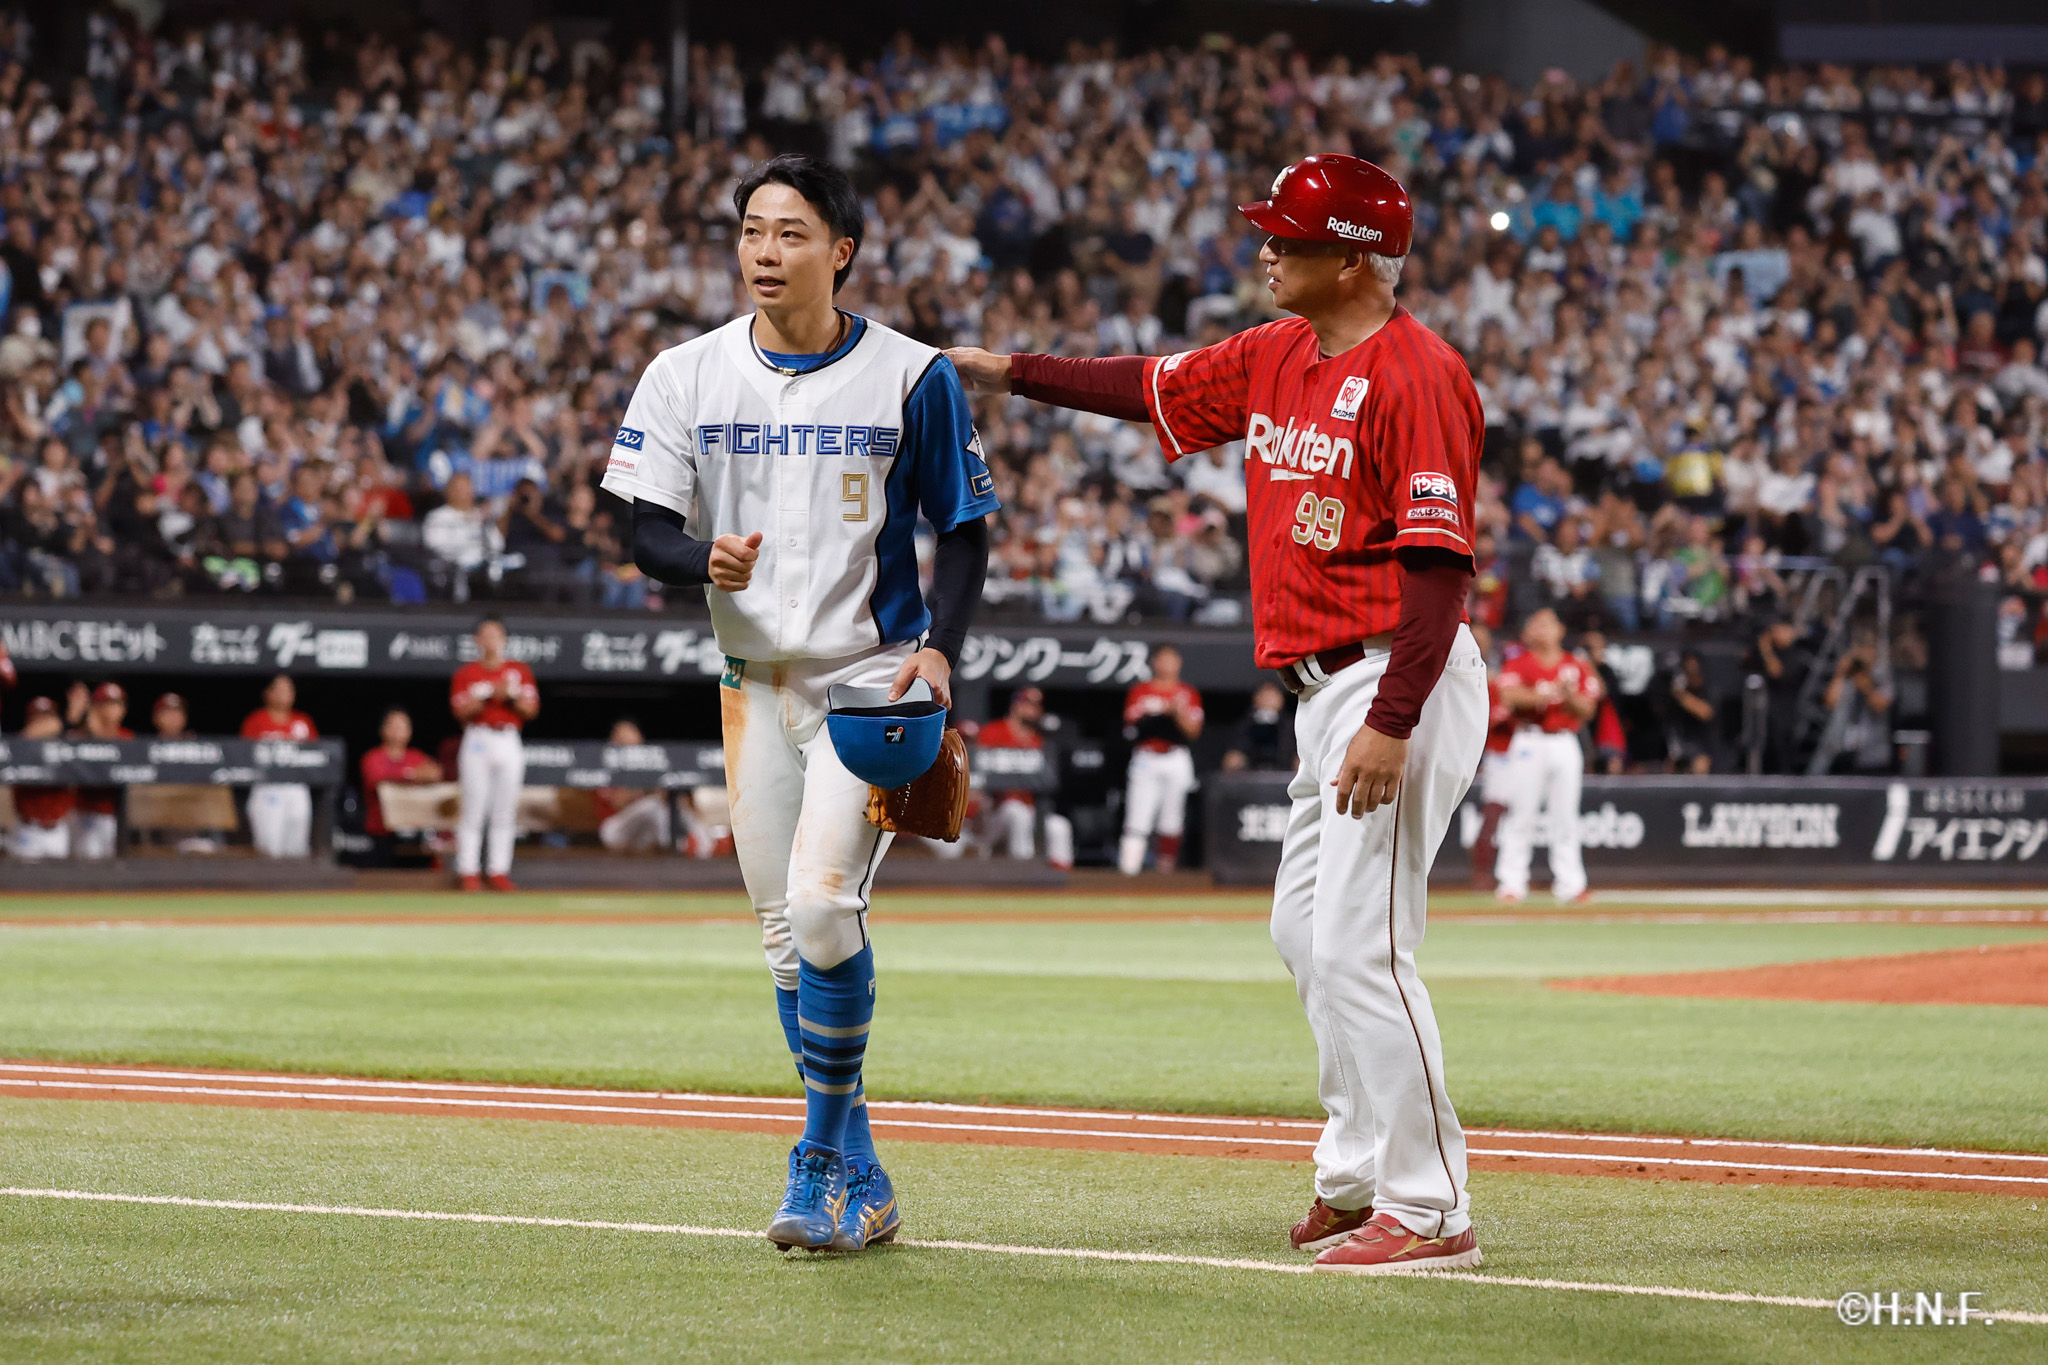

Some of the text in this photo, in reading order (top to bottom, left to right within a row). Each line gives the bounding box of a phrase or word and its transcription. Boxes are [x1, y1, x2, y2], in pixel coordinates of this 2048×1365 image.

[1326, 215, 1383, 242] Rakuten
[698, 422, 900, 457] FIGHTERS
[1245, 412, 1355, 481] Rakuten
[841, 472, 869, 522] 9
[1413, 476, 1458, 500] やまや
[1291, 491, 1346, 552] 99
[1681, 802, 1841, 848] LAWSON
